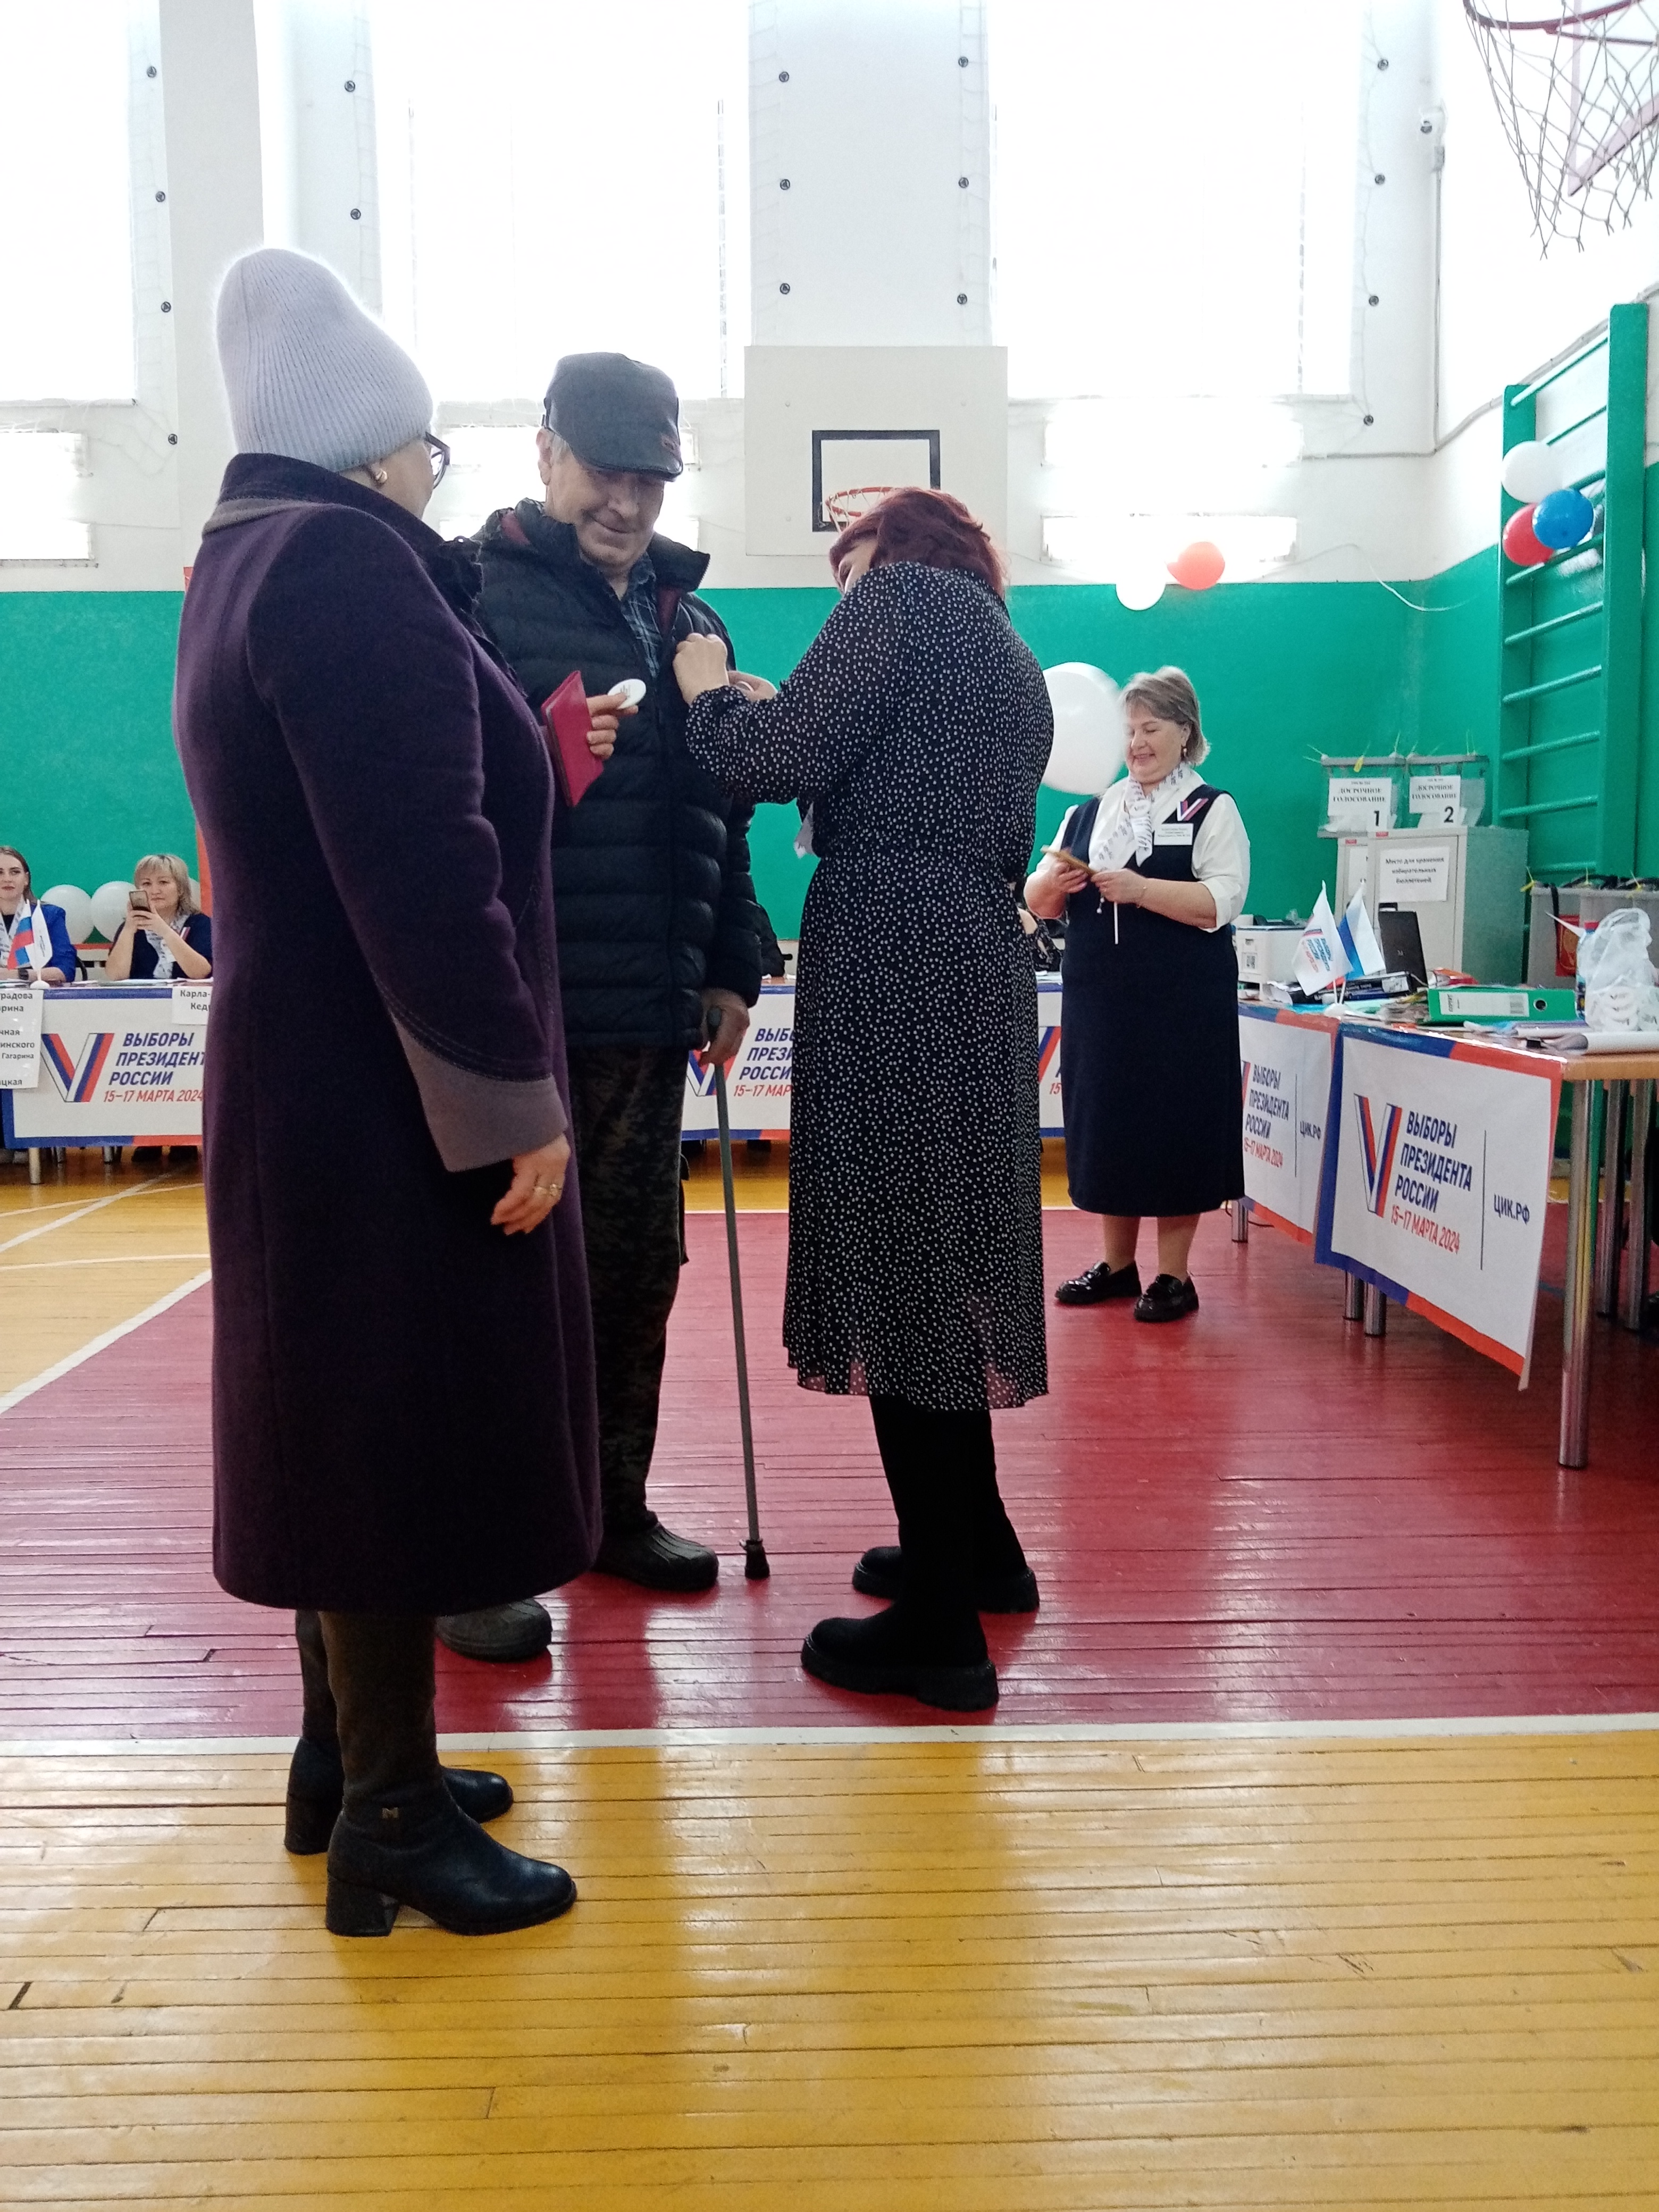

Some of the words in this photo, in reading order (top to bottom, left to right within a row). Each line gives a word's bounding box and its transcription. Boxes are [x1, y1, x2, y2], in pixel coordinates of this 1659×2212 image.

[1373, 810, 1380, 826] 1
[1444, 806, 1454, 823] 2
[180, 990, 211, 999] Карла-
[123, 1033, 195, 1047] ВЫБОРЫ
[108, 1071, 173, 1085] РОССИИ
[1253, 1063, 1281, 1090] ВЫБОРЫ
[136, 1090, 174, 1102] МАРТА
[177, 1089, 204, 1102] 2024
[1250, 1088, 1289, 1121] ПРЕЗИДЕНТА
[1245, 1113, 1271, 1139] РОССИИ
[1406, 1111, 1457, 1149] ВЫБОРЫ
[1255, 1143, 1271, 1162] МАРТА
[1400, 1142, 1472, 1192] ПРЕЗИДЕНТА
[1395, 1174, 1439, 1213] РОССИИ
[1494, 1193, 1530, 1226] ЦИК.РФ
[1411, 1213, 1438, 1245] МАРТА
[1439, 1226, 1460, 1255] 2024
